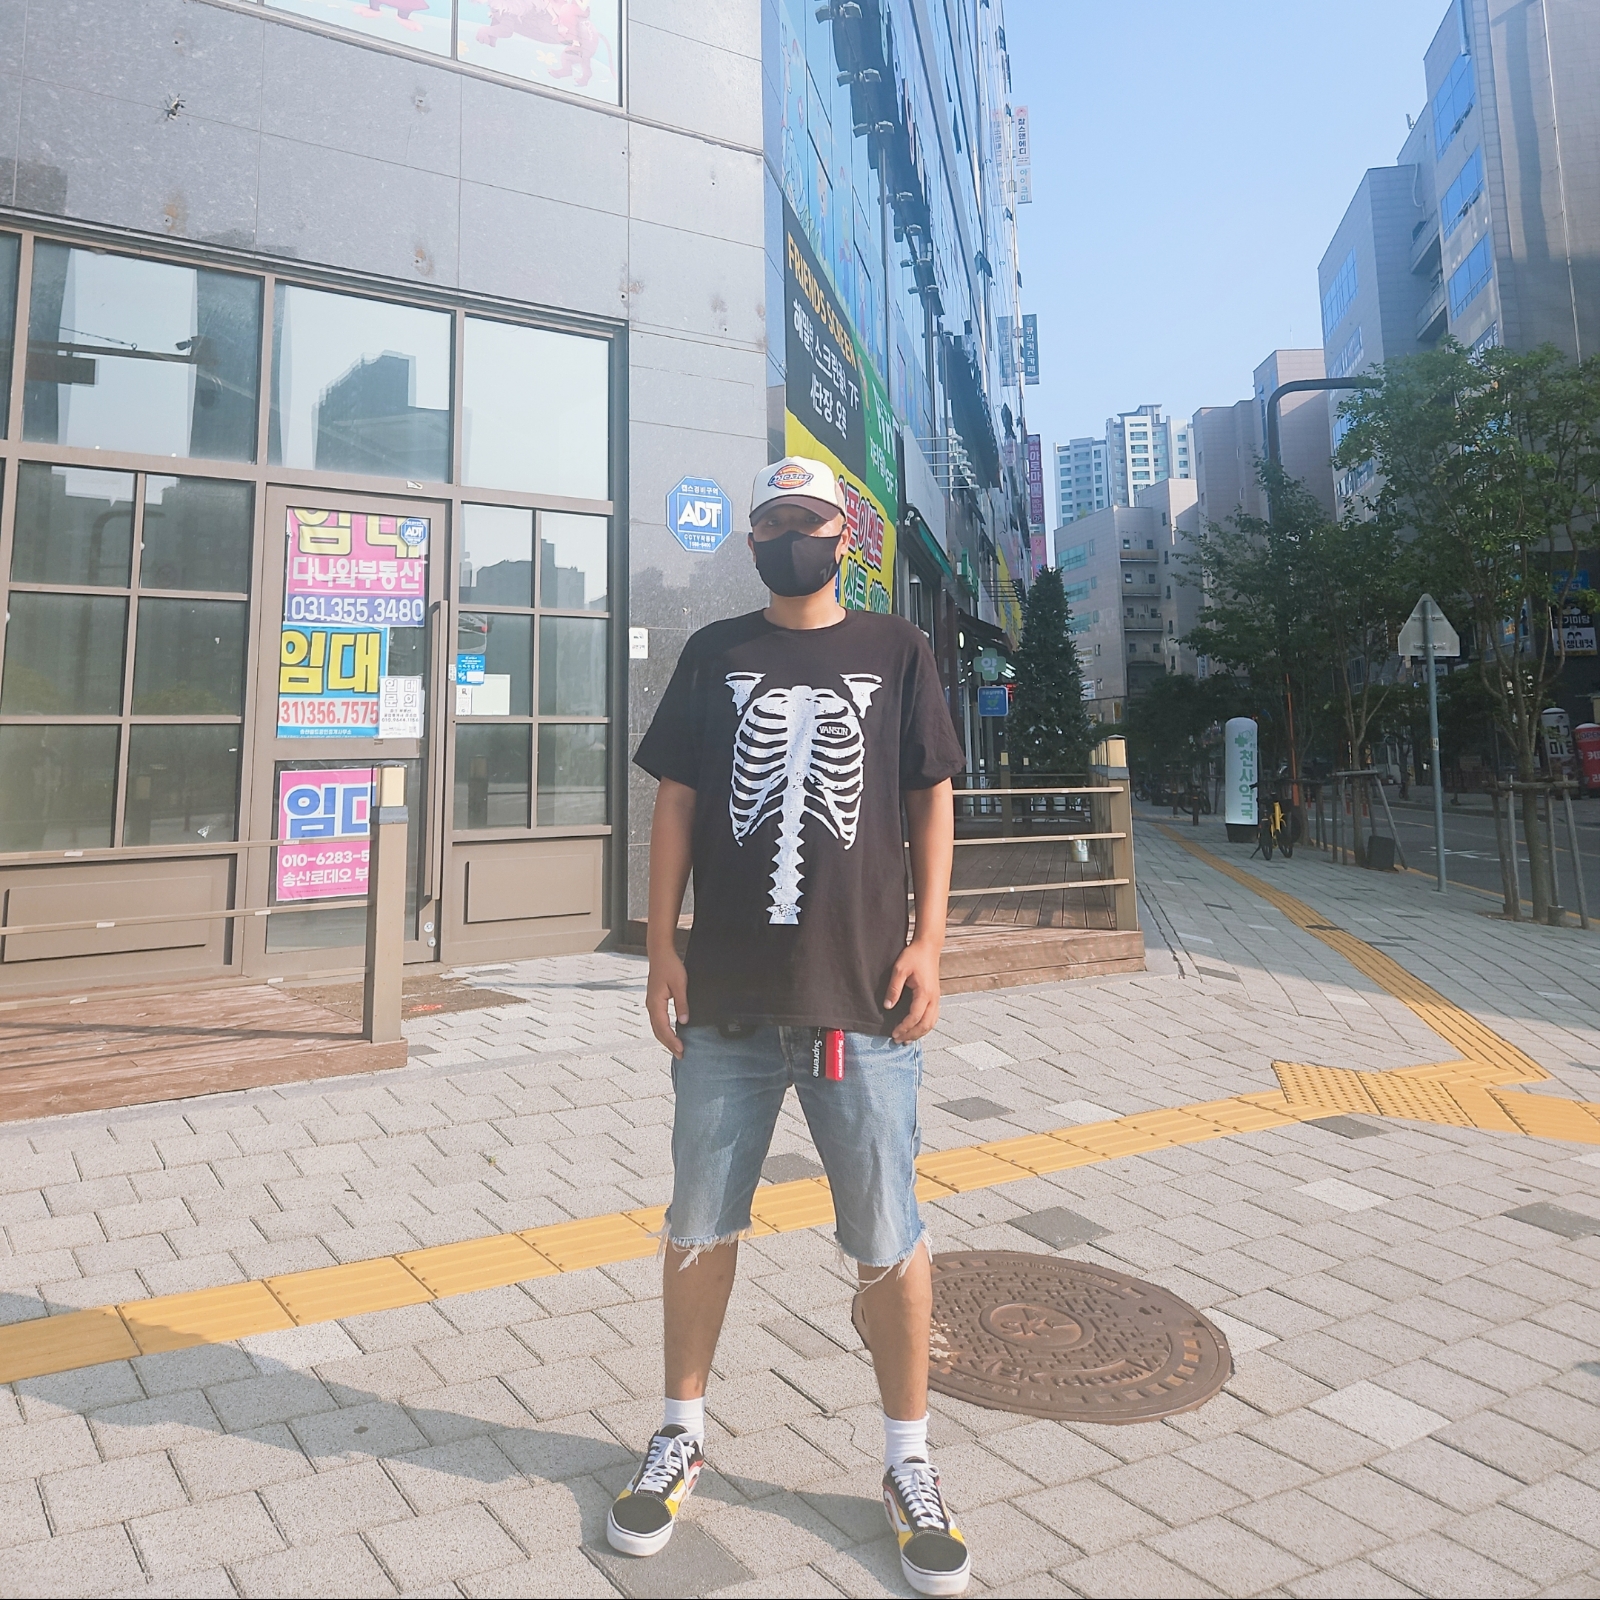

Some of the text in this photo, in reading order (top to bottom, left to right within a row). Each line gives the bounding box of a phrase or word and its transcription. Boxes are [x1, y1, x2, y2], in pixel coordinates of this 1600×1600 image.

[787, 230, 827, 325] FRIENDS
[1029, 450, 1042, 482] 아로마
[678, 500, 722, 528] ADT
[404, 526, 423, 537] ADT
[293, 557, 421, 590] 다나와부동산
[291, 596, 424, 622] 031.355.3480
[280, 630, 382, 693] 임대
[981, 657, 997, 674] 약
[1239, 749, 1254, 820] 천사약국
[282, 867, 352, 887] 송산로데오
[812, 1039, 823, 1078] Supreme
